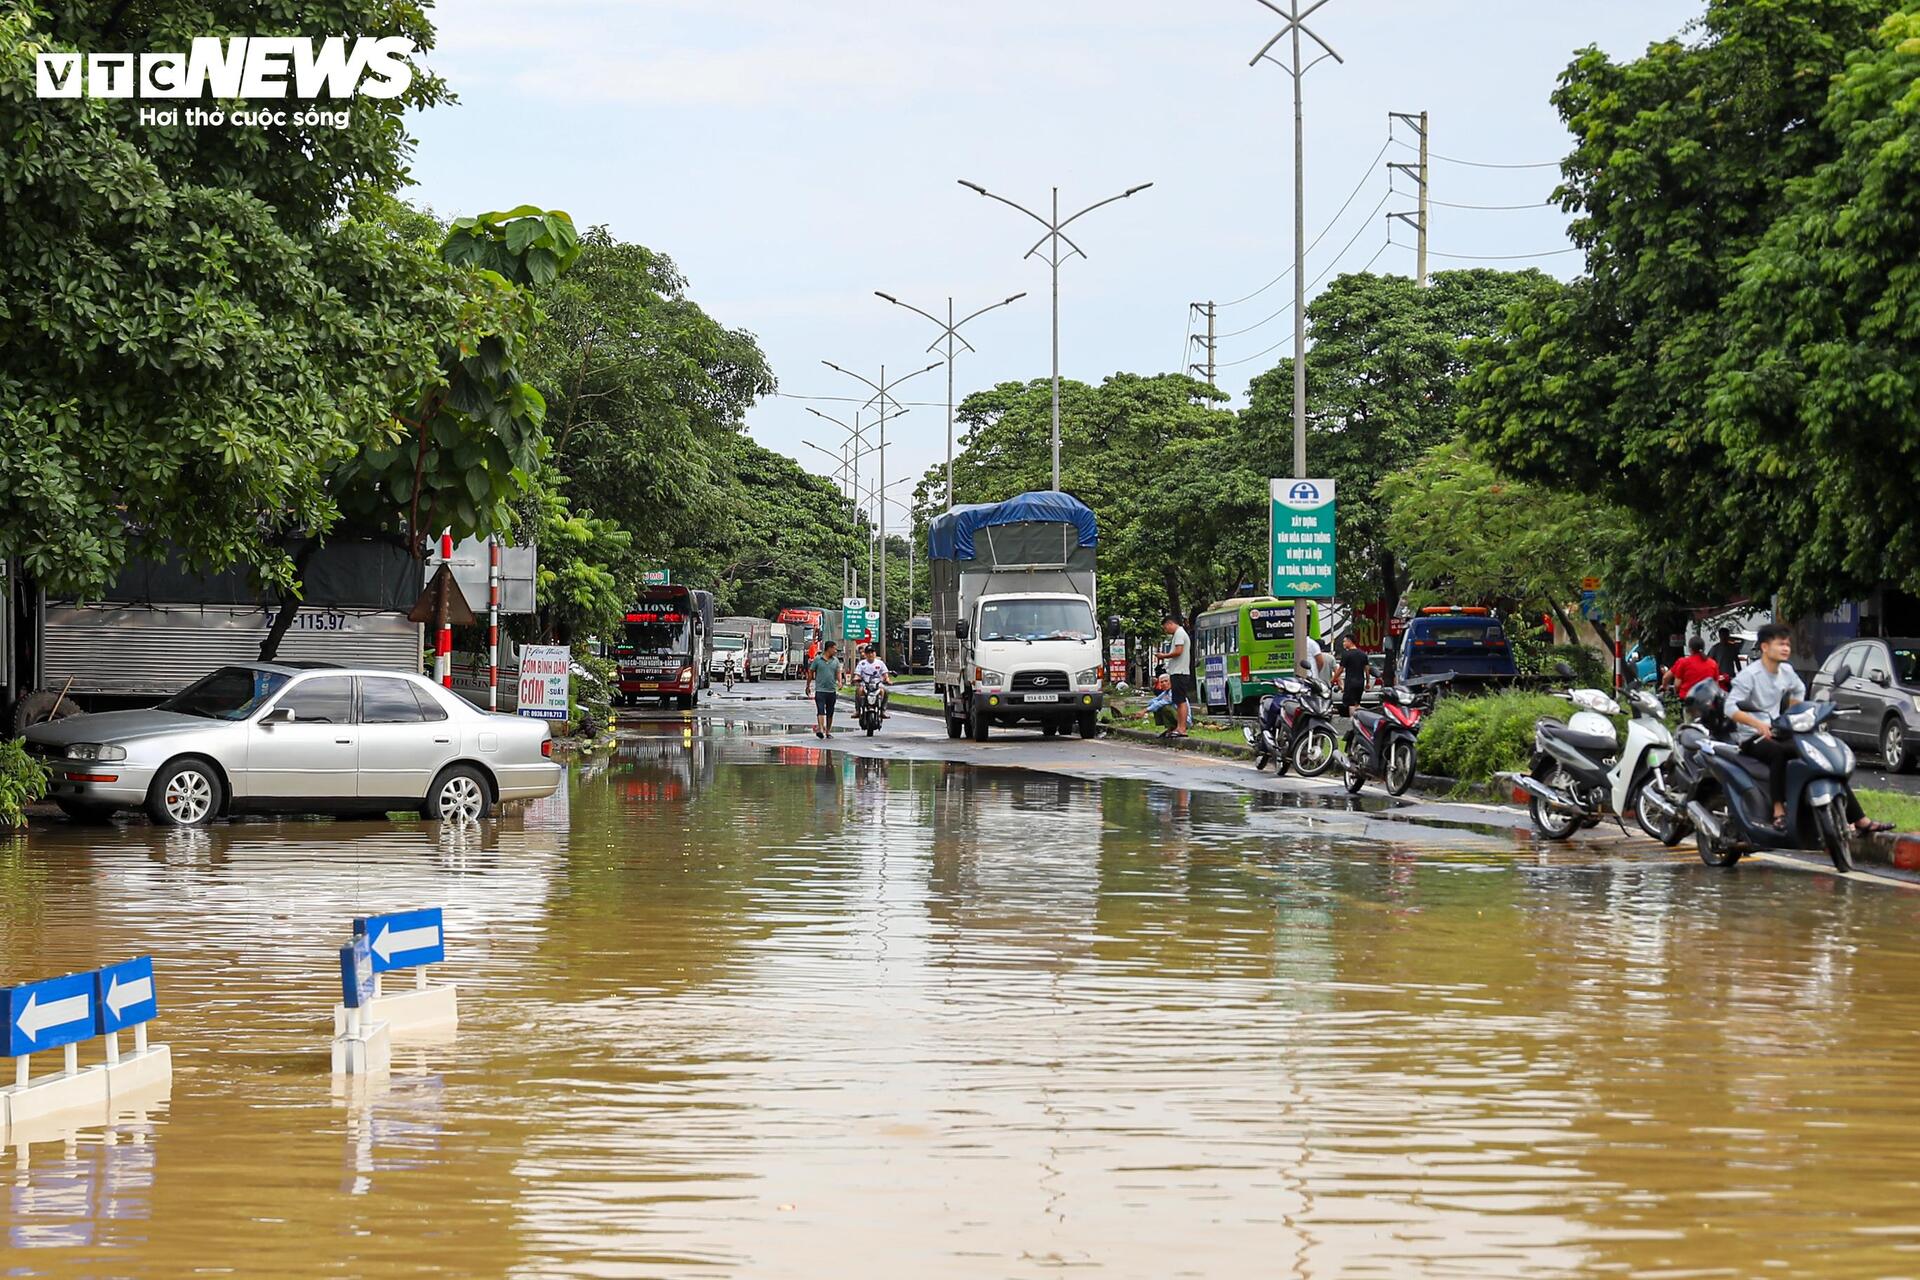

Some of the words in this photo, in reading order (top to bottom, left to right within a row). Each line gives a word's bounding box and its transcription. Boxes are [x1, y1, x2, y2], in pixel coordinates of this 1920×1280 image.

[266, 612, 346, 630] 2-115.97
[537, 658, 553, 674] BÌNH
[553, 658, 567, 675] DÂN
[521, 677, 545, 705] CƠM
